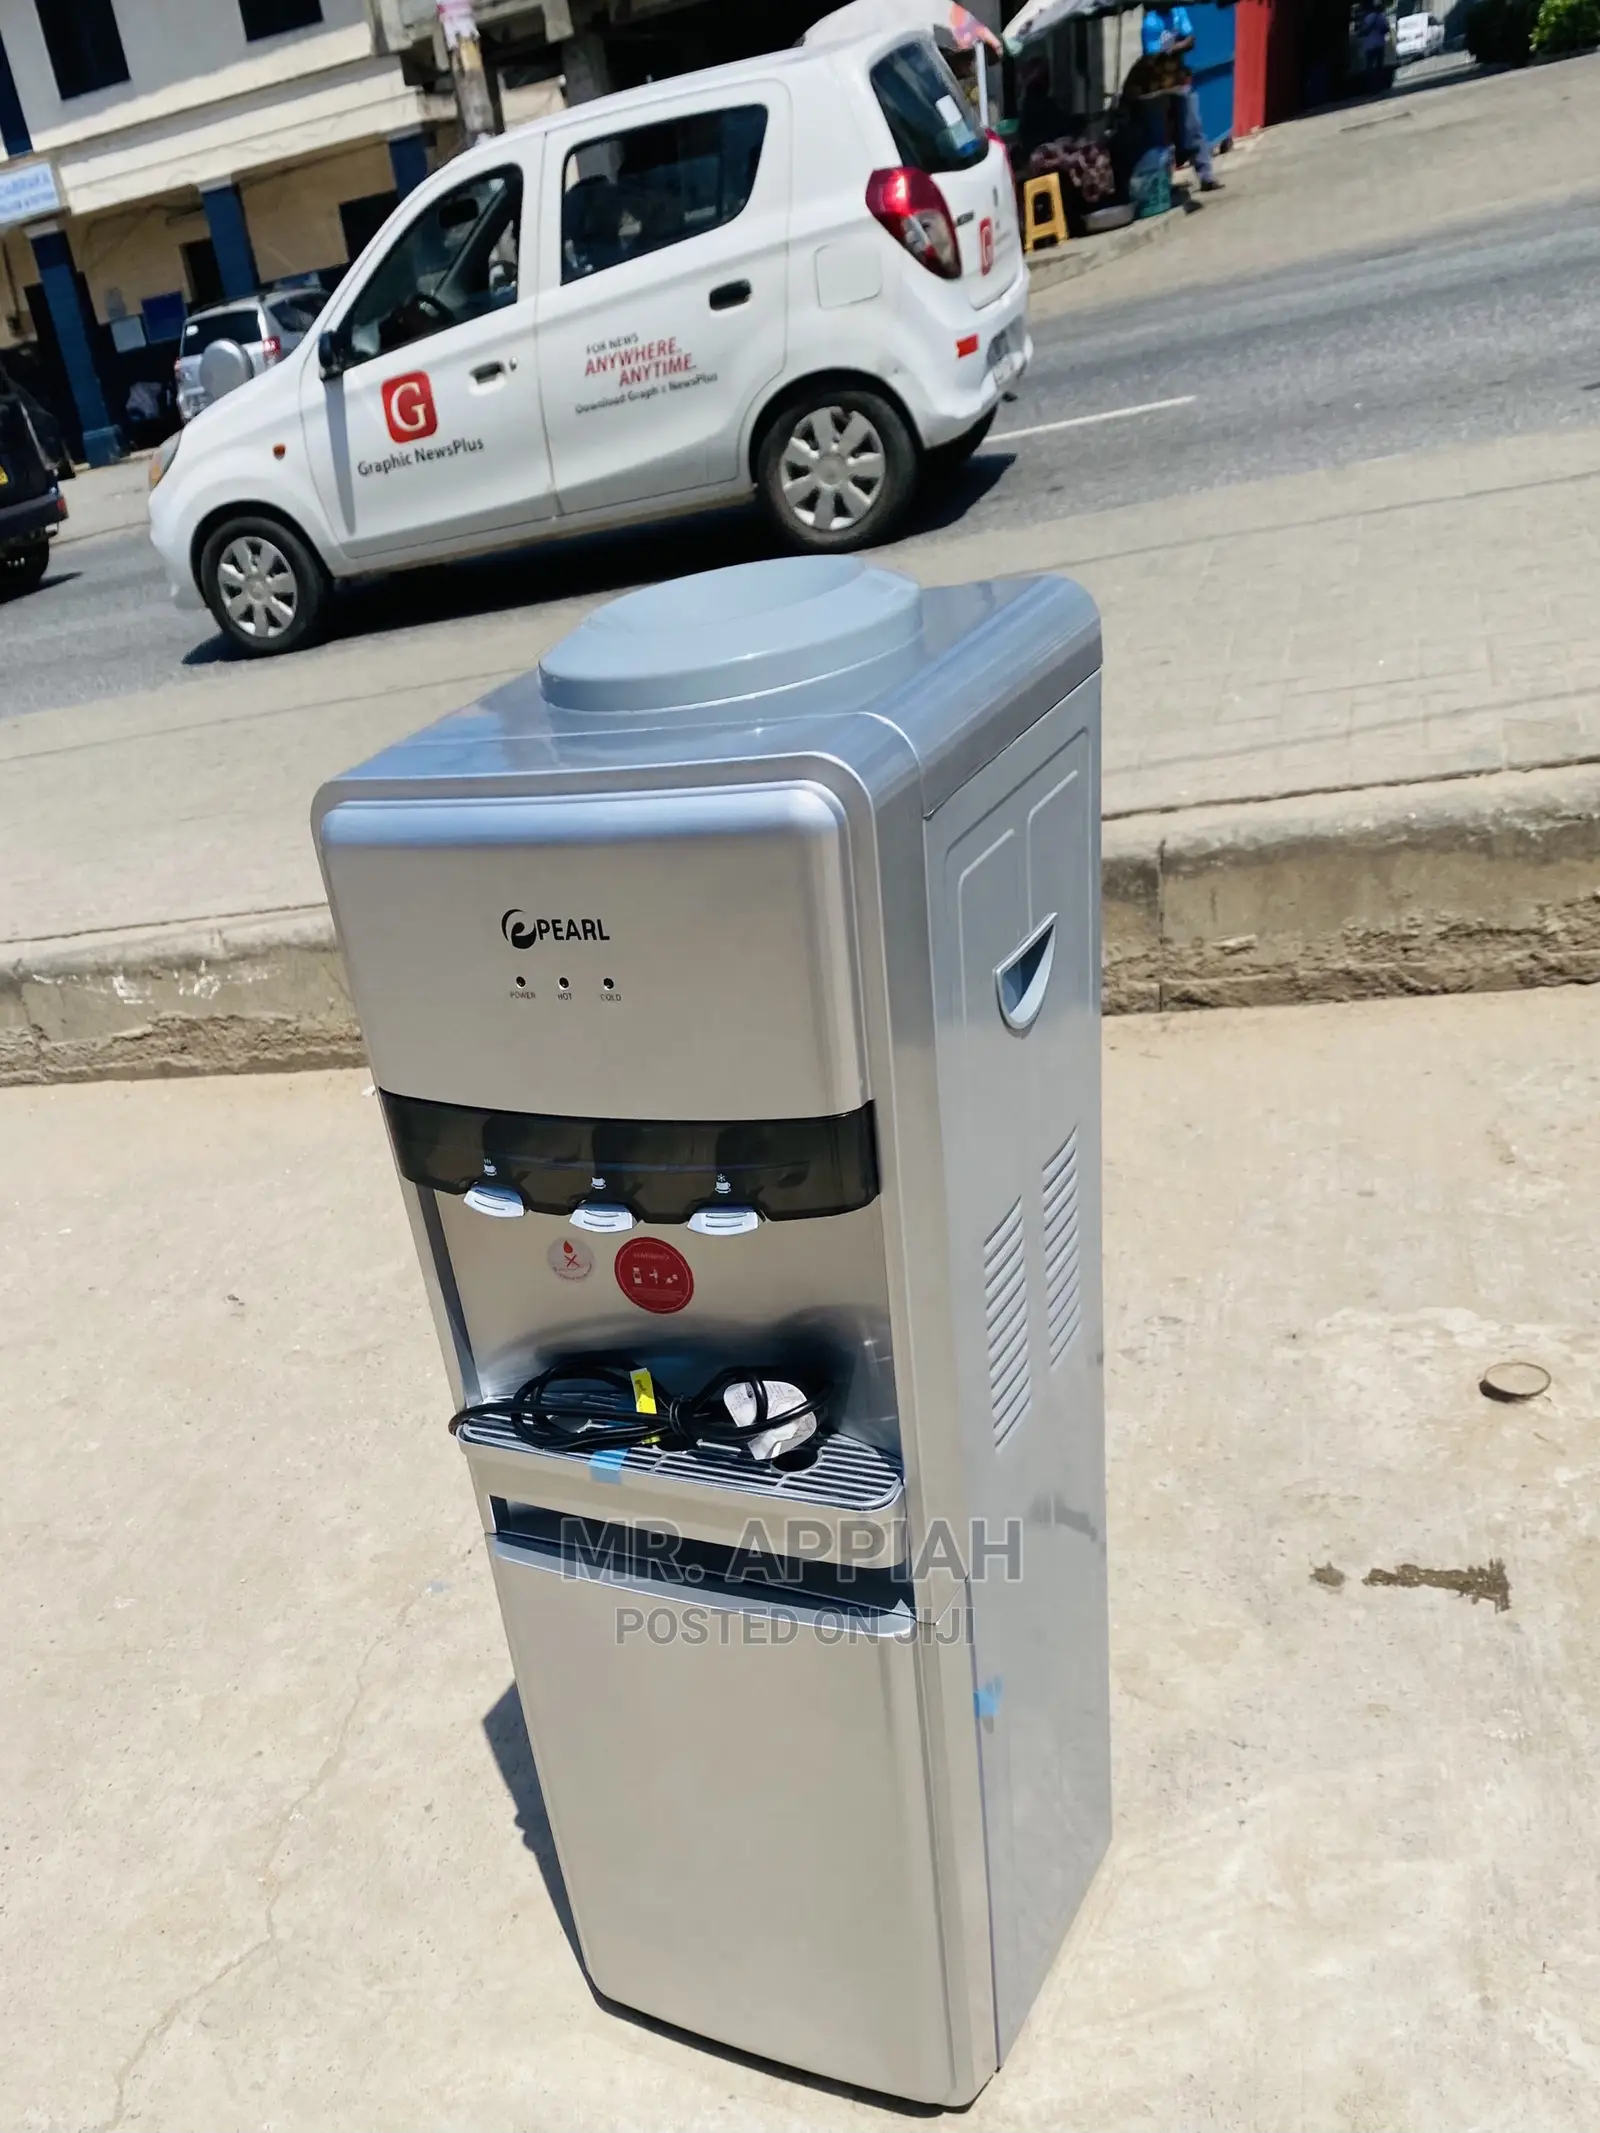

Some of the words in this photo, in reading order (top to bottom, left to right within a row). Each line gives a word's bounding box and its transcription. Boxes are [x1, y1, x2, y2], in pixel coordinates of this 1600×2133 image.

[586, 342, 607, 355] FOR
[608, 332, 639, 349] NEWS
[390, 381, 427, 432] G
[357, 451, 413, 477] Graphic
[414, 437, 485, 463] NewsPlus
[536, 918, 611, 941] PEARL
[509, 991, 536, 1000] POWER
[557, 992, 572, 1001] HOT
[600, 993, 622, 1002] COLD
